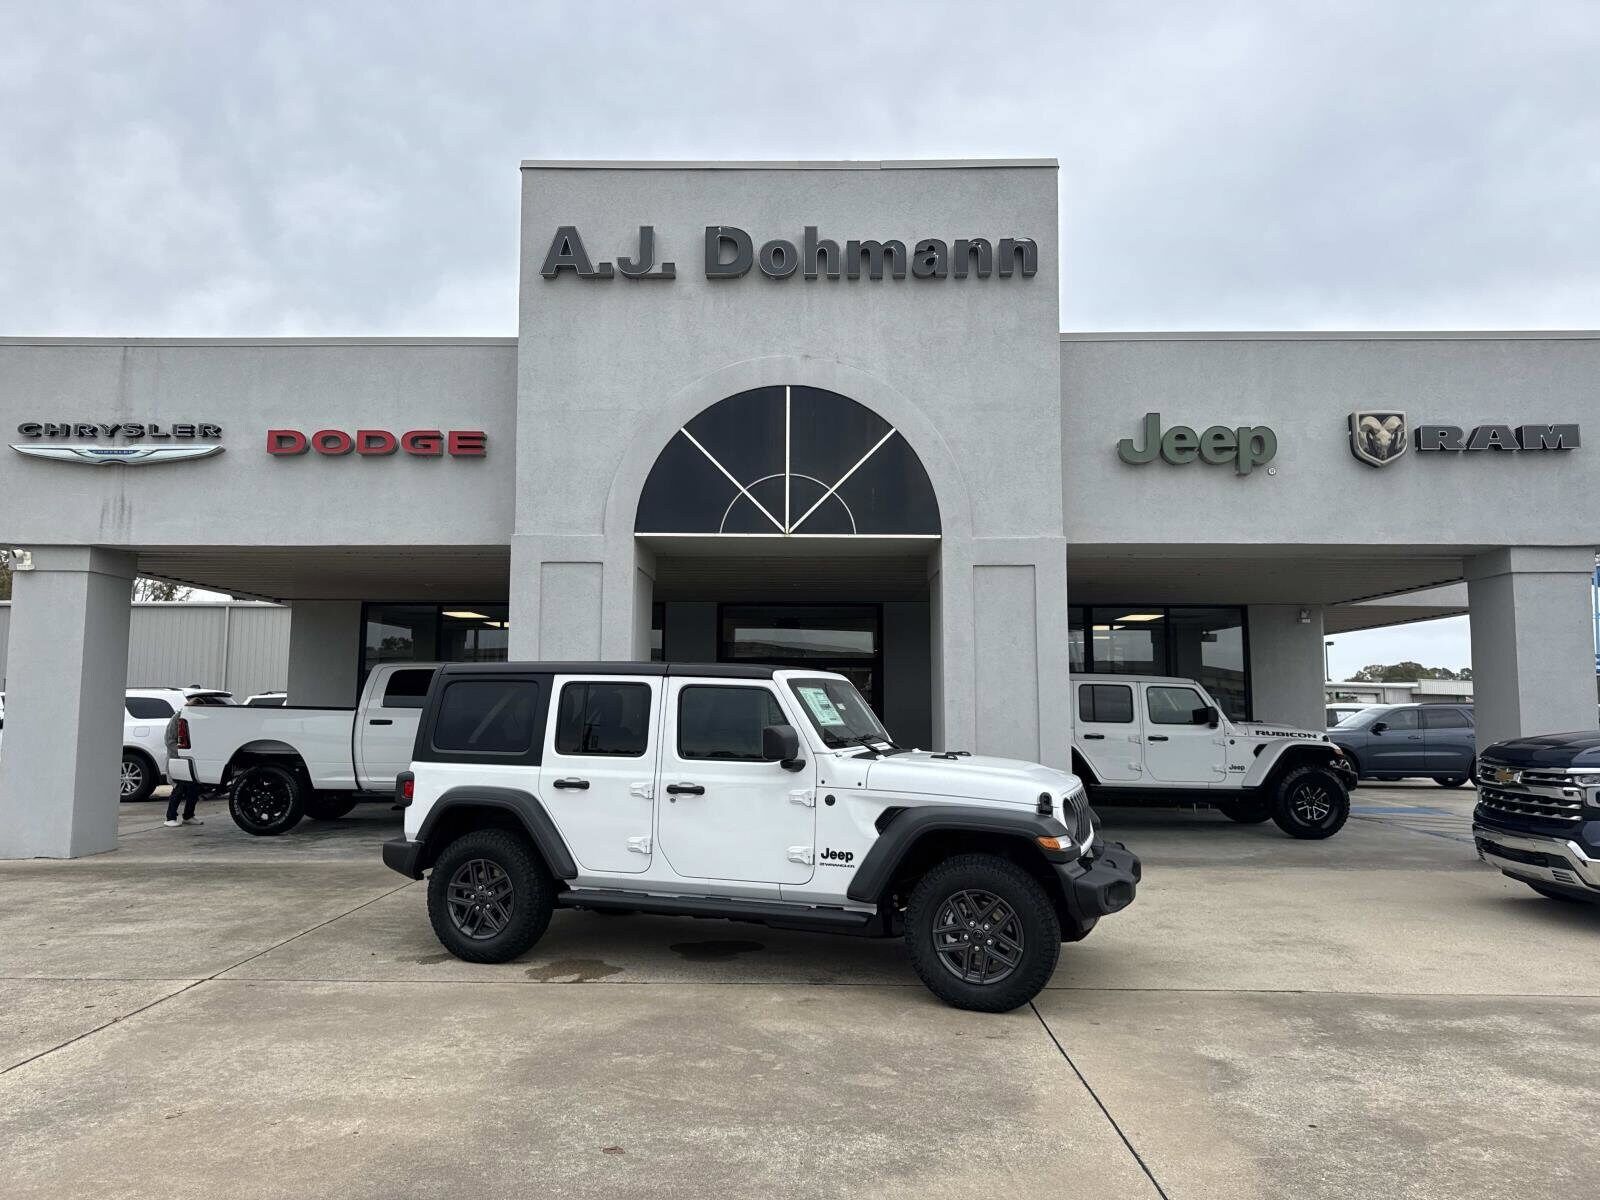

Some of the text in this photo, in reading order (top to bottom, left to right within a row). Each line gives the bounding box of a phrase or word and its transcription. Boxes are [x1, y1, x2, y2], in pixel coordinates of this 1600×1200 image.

[540, 225, 1039, 279] A.J. Dohmann
[17, 422, 223, 439] CHRYSLER
[267, 430, 488, 457] DODGE
[1415, 424, 1582, 452] RAM
[1117, 413, 1278, 476] Jeep
[1255, 730, 1318, 739] RUBICON
[820, 847, 853, 862] Jeep
